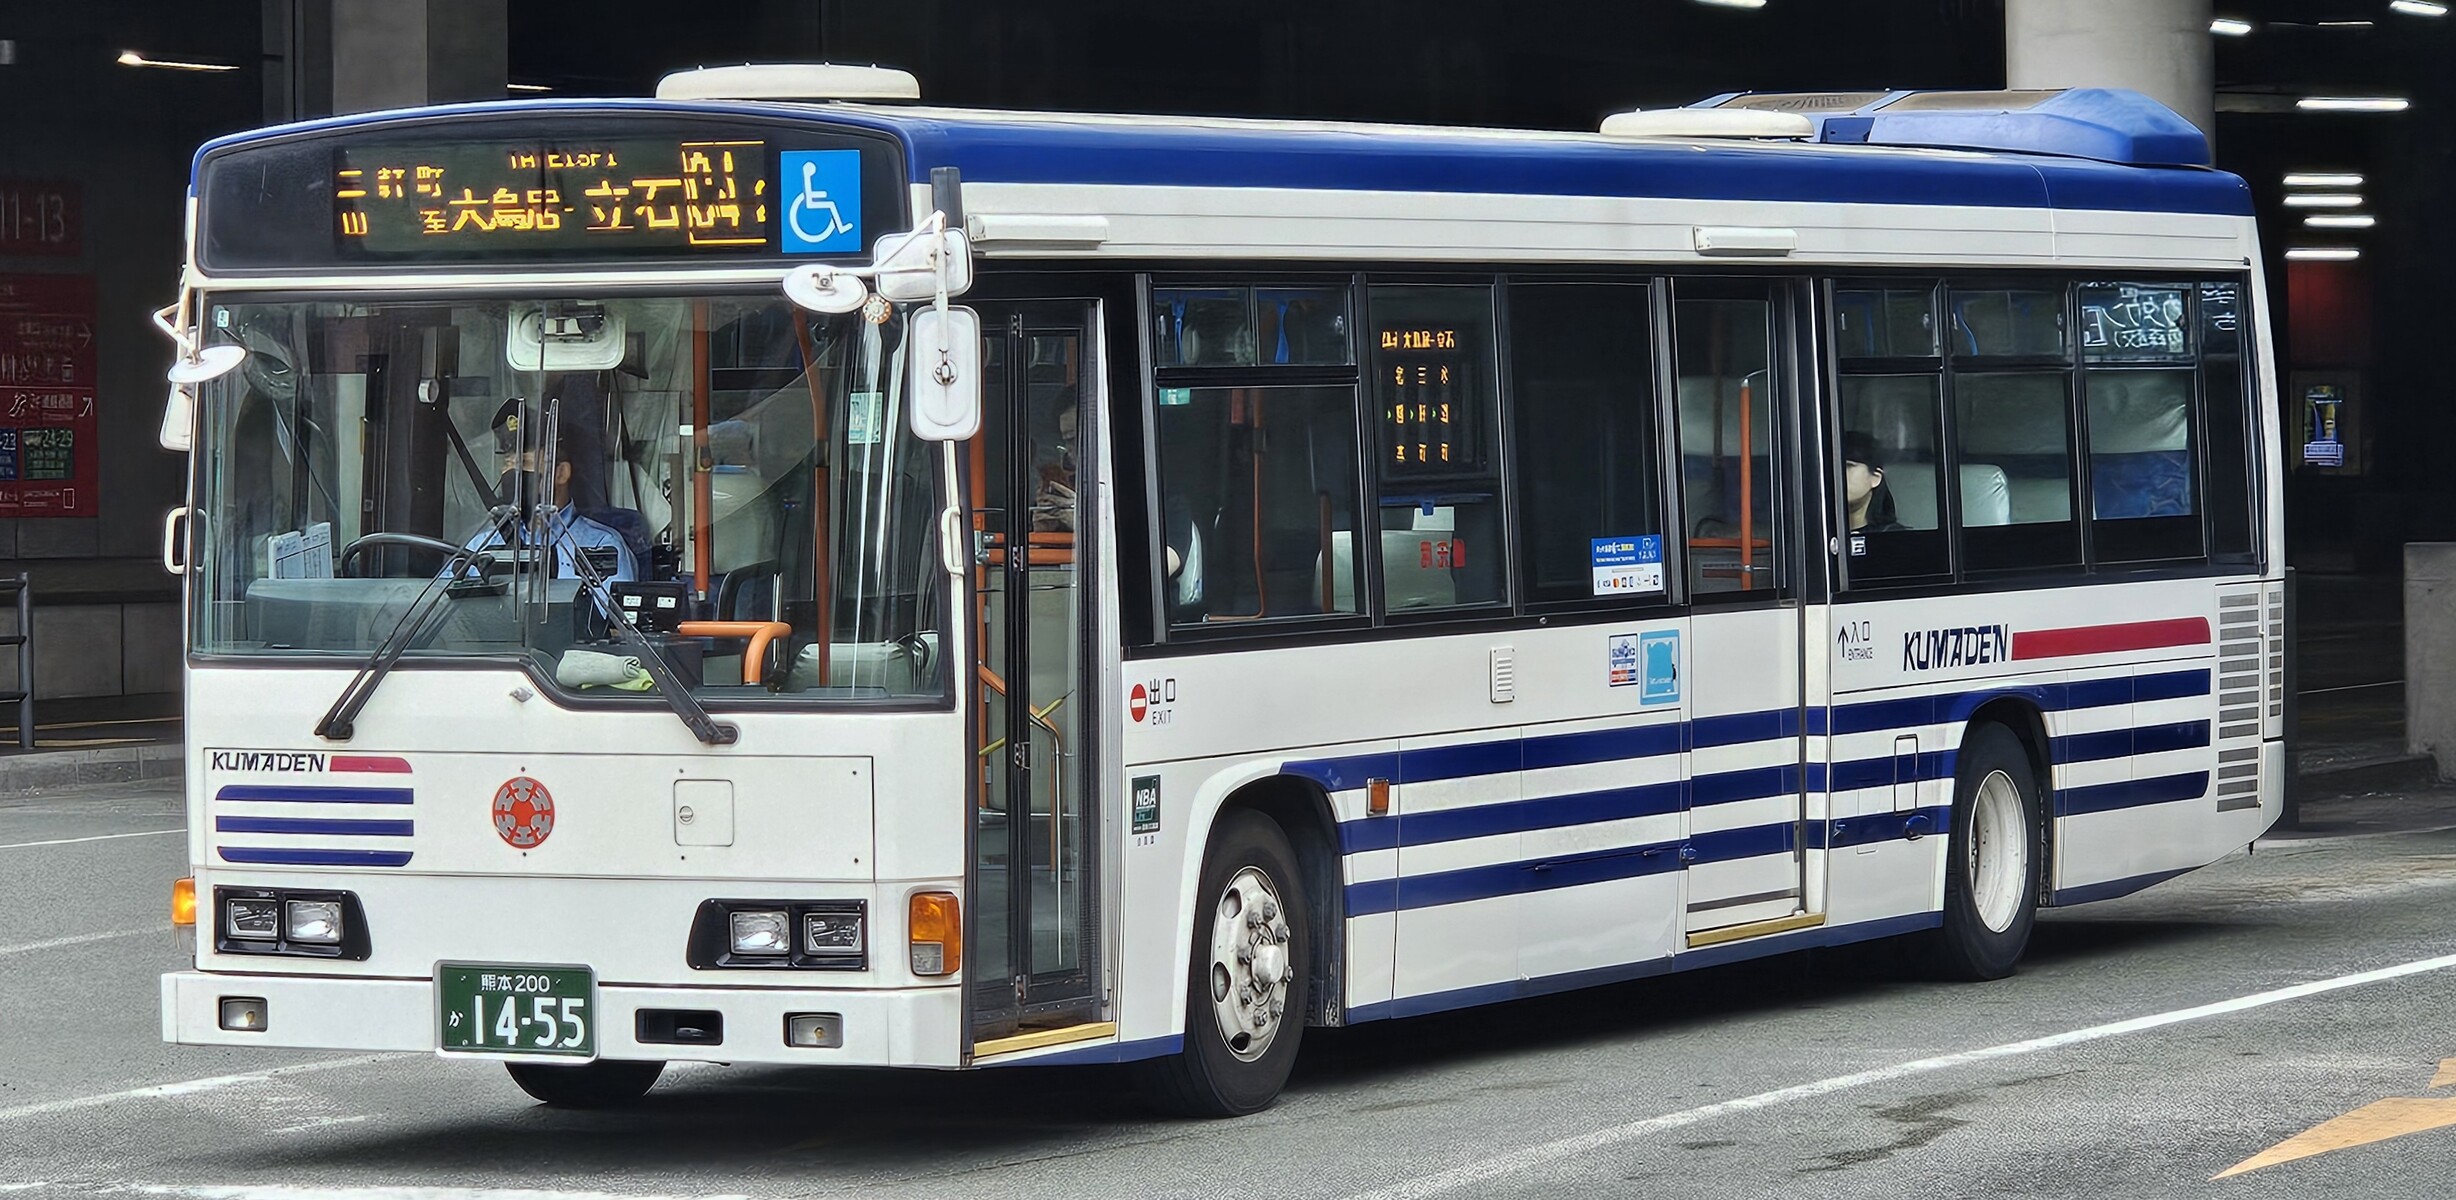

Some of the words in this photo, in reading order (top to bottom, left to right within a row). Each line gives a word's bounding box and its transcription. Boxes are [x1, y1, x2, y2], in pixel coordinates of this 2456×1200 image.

[1851, 621, 1870, 643] 入口
[1903, 623, 2009, 672] KUMADEN
[1149, 678, 1176, 705] 出口
[1152, 709, 1172, 726] EXIT
[211, 751, 325, 773] KUMADEN
[1136, 788, 1157, 806] NBA
[448, 1010, 464, 1027] か
[474, 995, 586, 1048] 14-55
